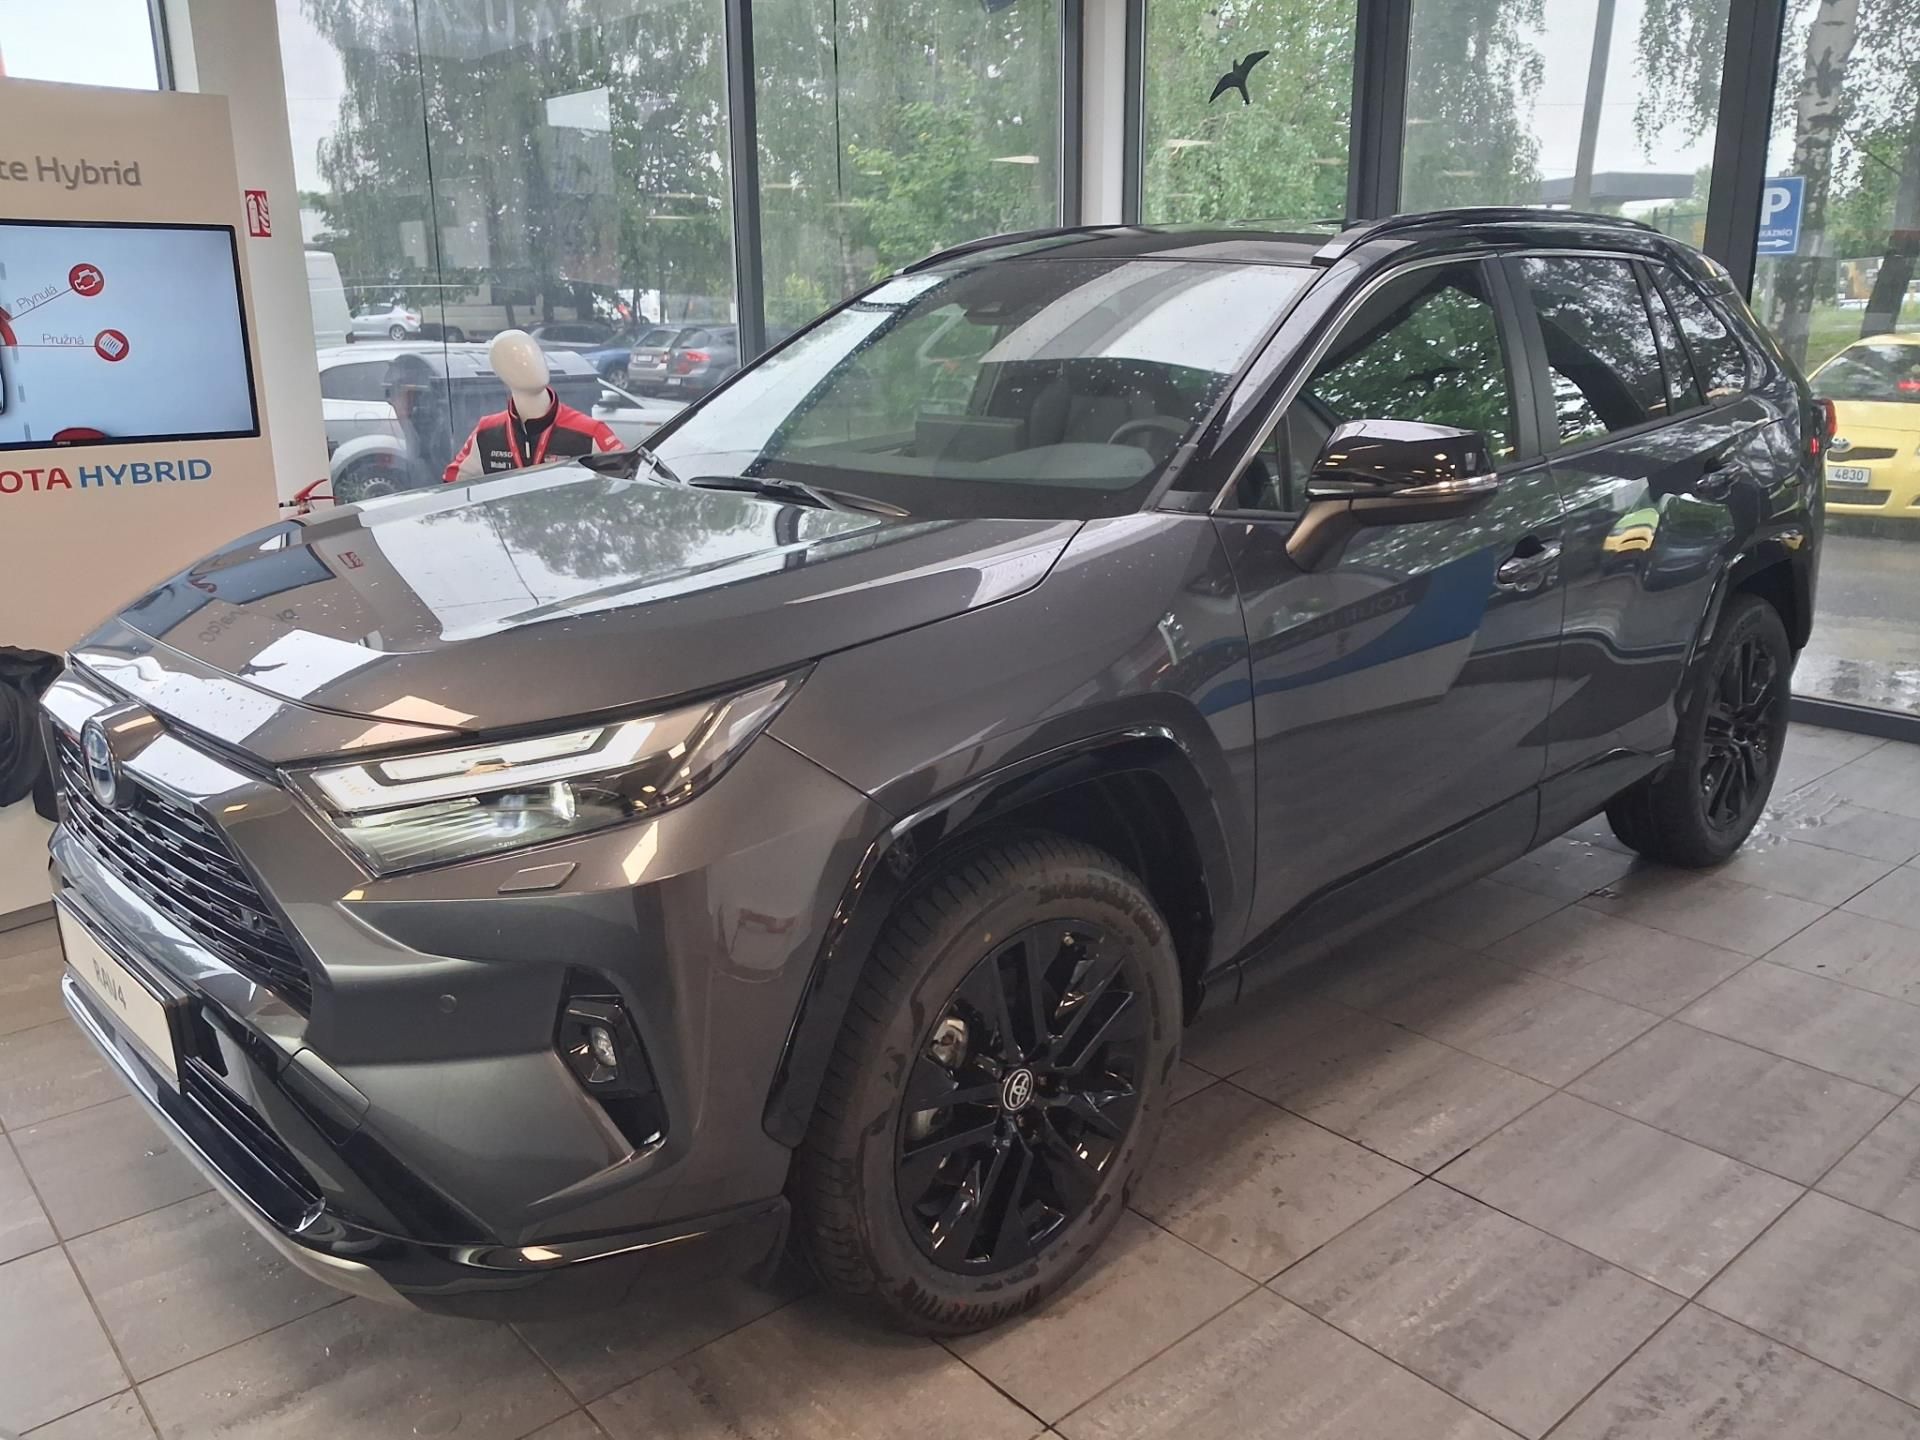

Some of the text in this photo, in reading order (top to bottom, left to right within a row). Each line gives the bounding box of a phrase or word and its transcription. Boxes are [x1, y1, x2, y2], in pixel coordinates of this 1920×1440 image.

[36, 155, 142, 190] Hybrid
[1761, 187, 1791, 225] P
[16, 284, 58, 309] Plynulá
[42, 333, 84, 345] Pružná
[490, 450, 513, 458] DENSO
[0, 459, 212, 493] OTA HYBRID
[1834, 469, 1864, 480] 4830
[92, 958, 127, 1009] RAV4
